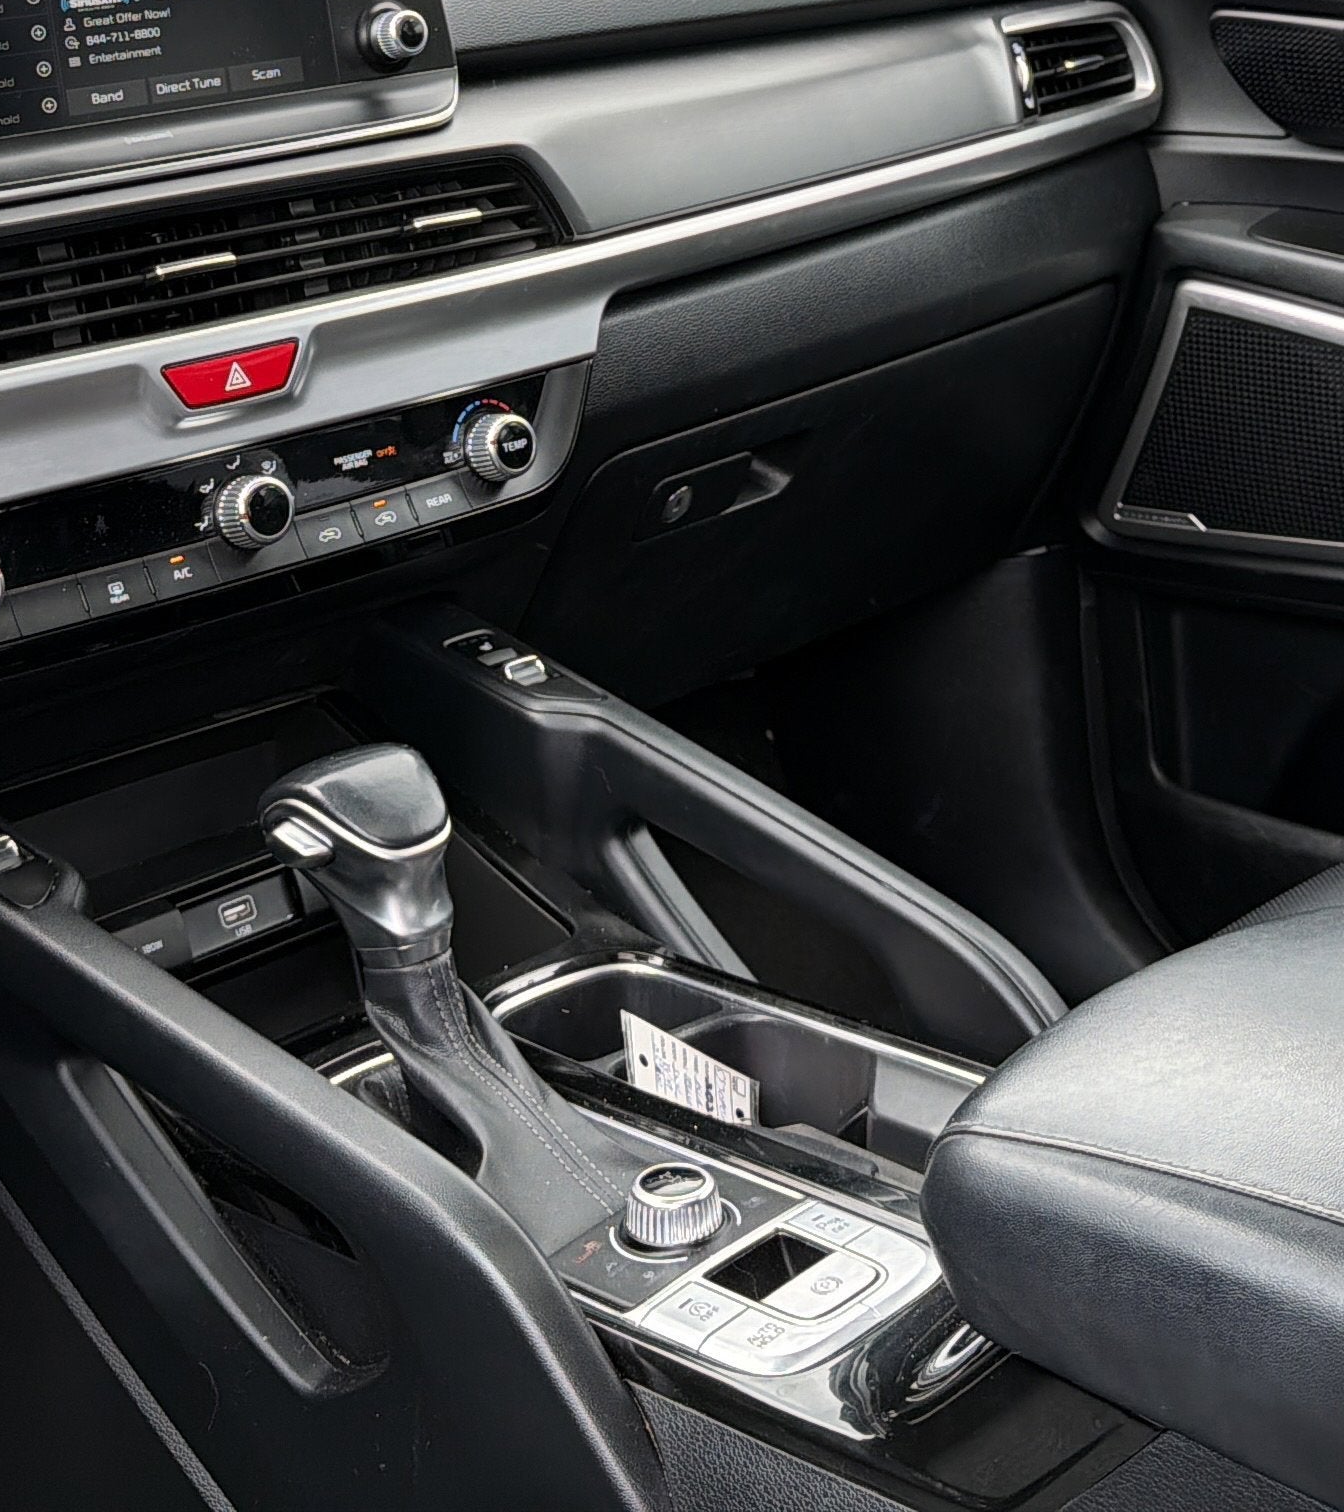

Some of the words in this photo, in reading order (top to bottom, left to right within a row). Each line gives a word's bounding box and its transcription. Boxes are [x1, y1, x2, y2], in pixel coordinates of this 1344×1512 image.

[83, 15, 115, 29] Great
[115, 12, 144, 25] Offer
[144, 8, 171, 20] Now!
[86, 27, 161, 47] 844-711-8800
[89, 46, 162, 65] Entertainment
[252, 67, 282, 81] Scan
[156, 81, 192, 96] Direct
[192, 77, 222, 91] Tune
[91, 90, 125, 105] Band
[502, 438, 529, 452] TEMP
[425, 493, 453, 509] REAR
[173, 566, 194, 581] A/C
[235, 924, 253, 938] USB
